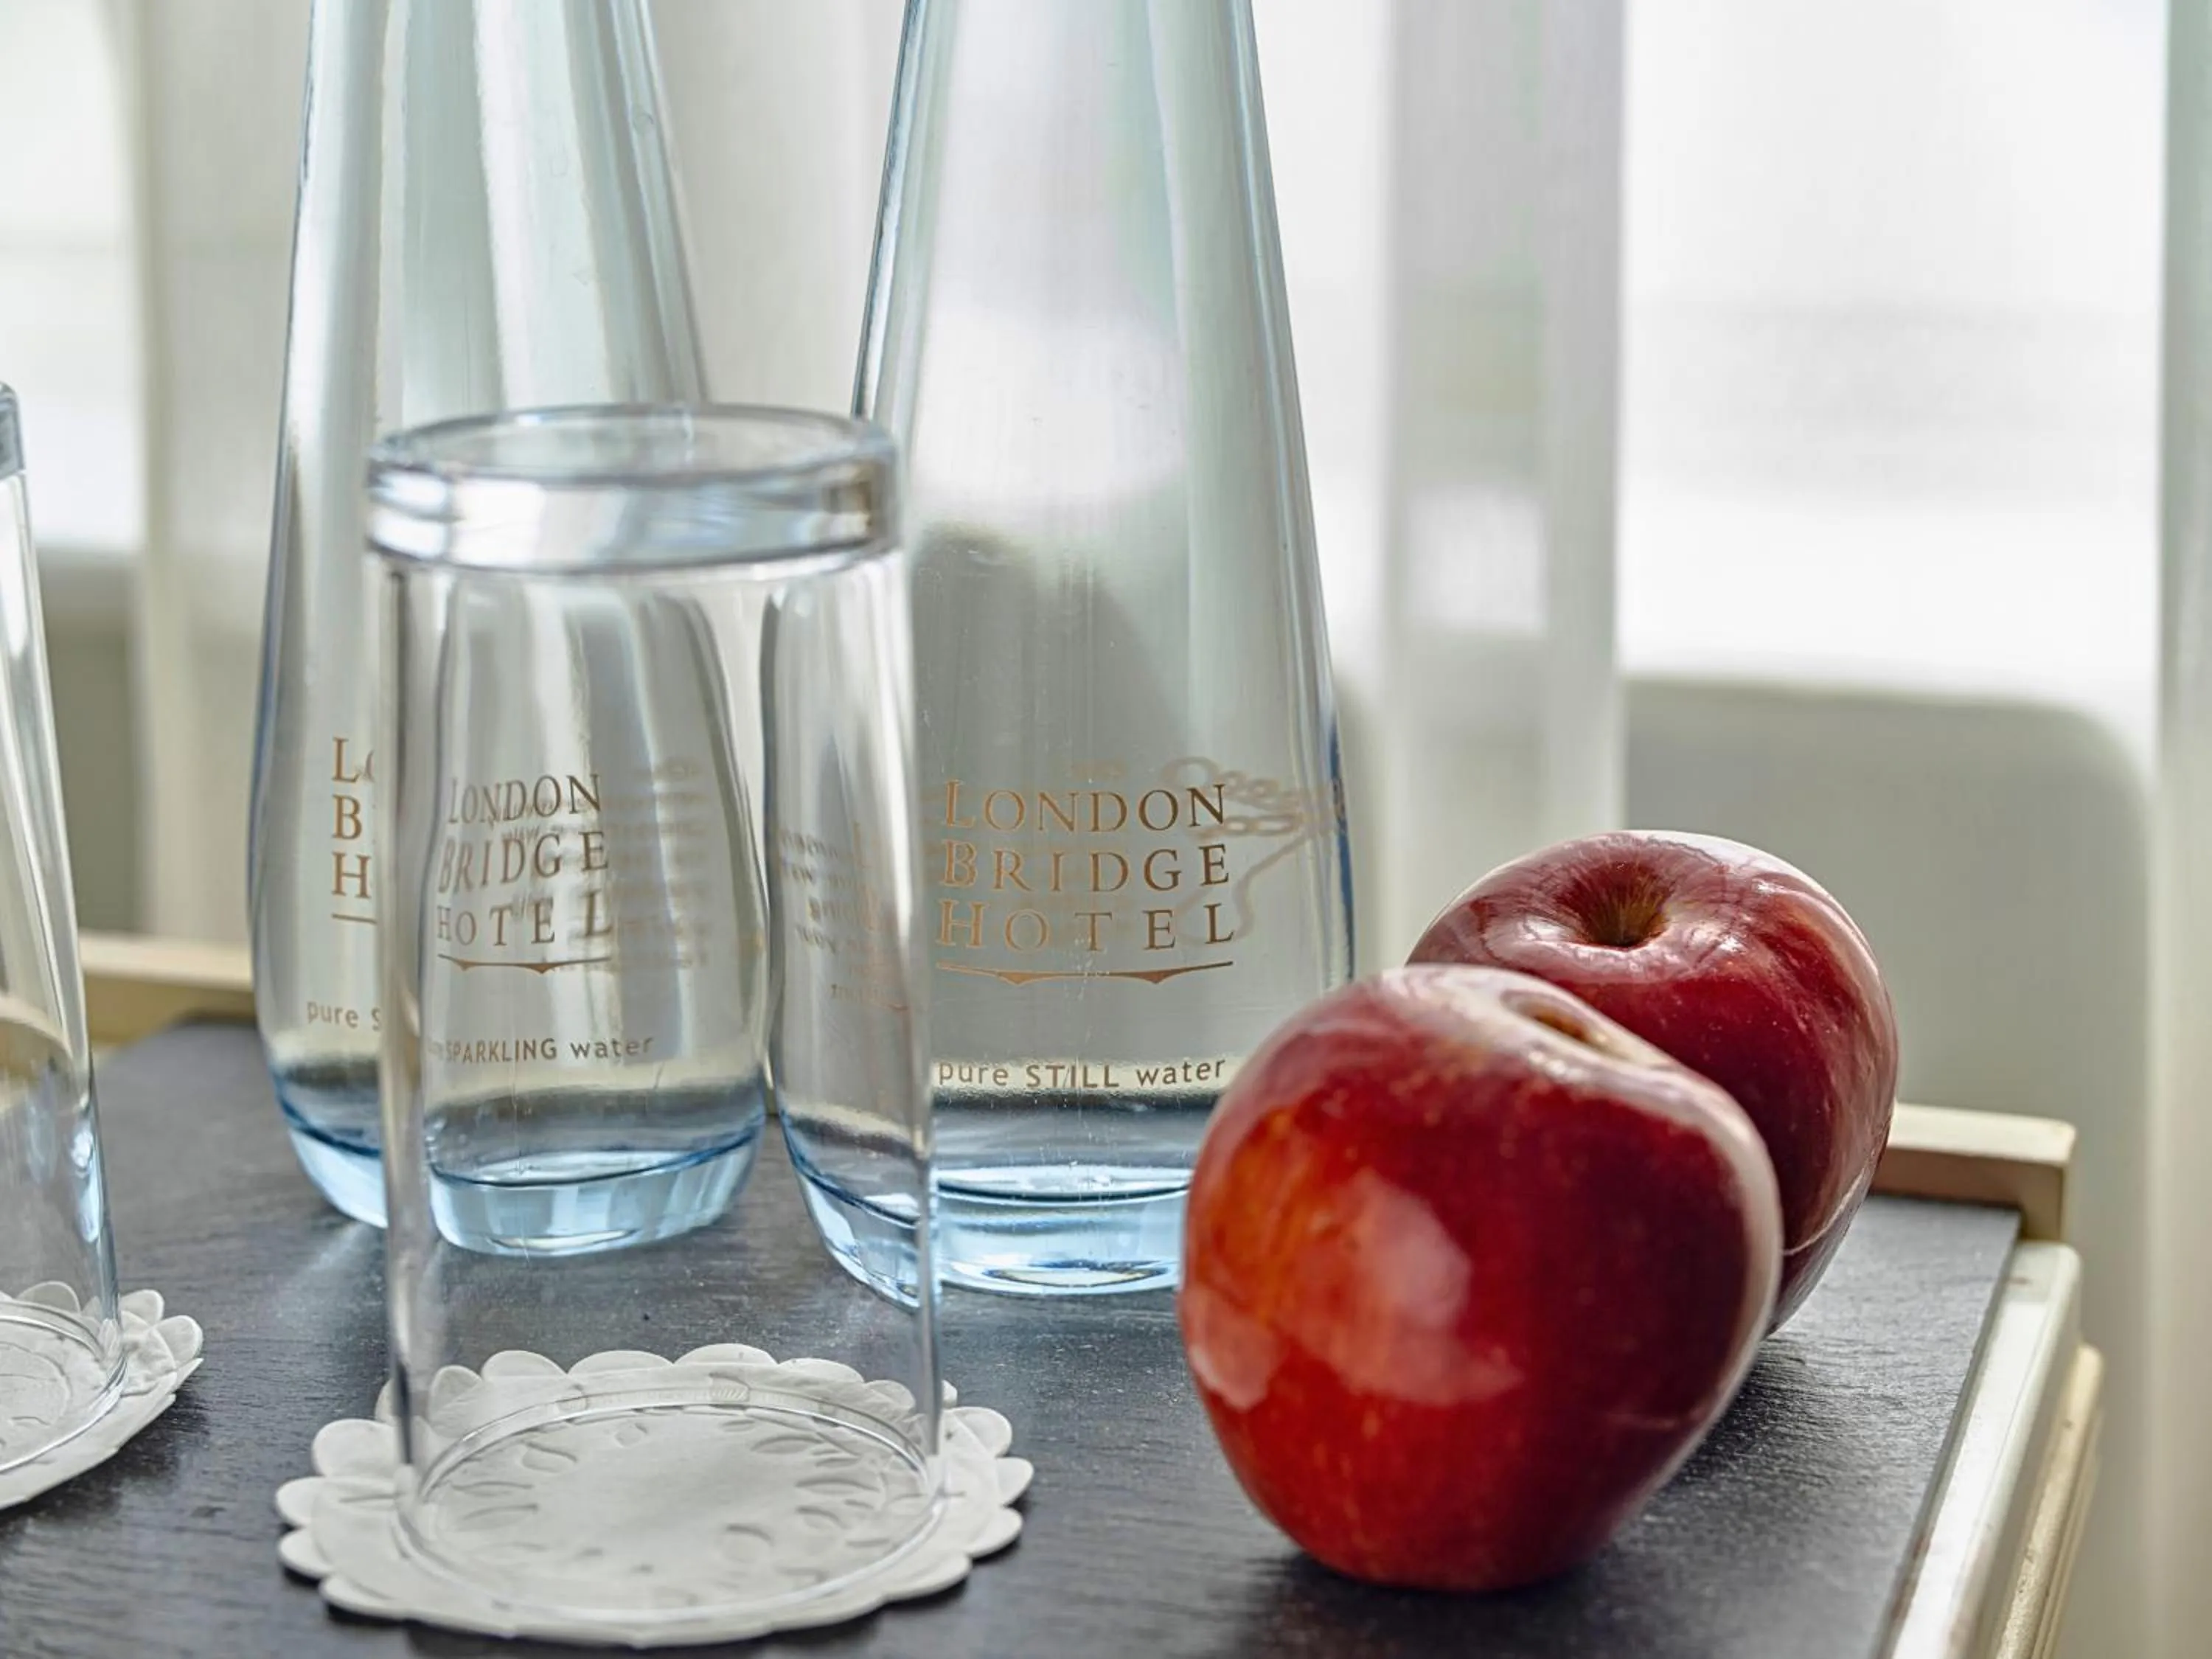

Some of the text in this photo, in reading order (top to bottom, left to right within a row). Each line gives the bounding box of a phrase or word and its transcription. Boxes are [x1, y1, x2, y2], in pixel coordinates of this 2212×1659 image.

[448, 773, 601, 827] LONDON
[945, 779, 1225, 833] LONDON
[438, 830, 608, 894] BRIDGE
[941, 839, 1230, 893] BRIDGE
[437, 888, 611, 947] HOTEL
[936, 898, 1235, 952] HOTEL
[307, 1001, 359, 1029] pure
[445, 1037, 558, 1064] SPARKLING
[570, 1037, 654, 1060] water
[938, 1058, 1226, 1088] pure STILL water
